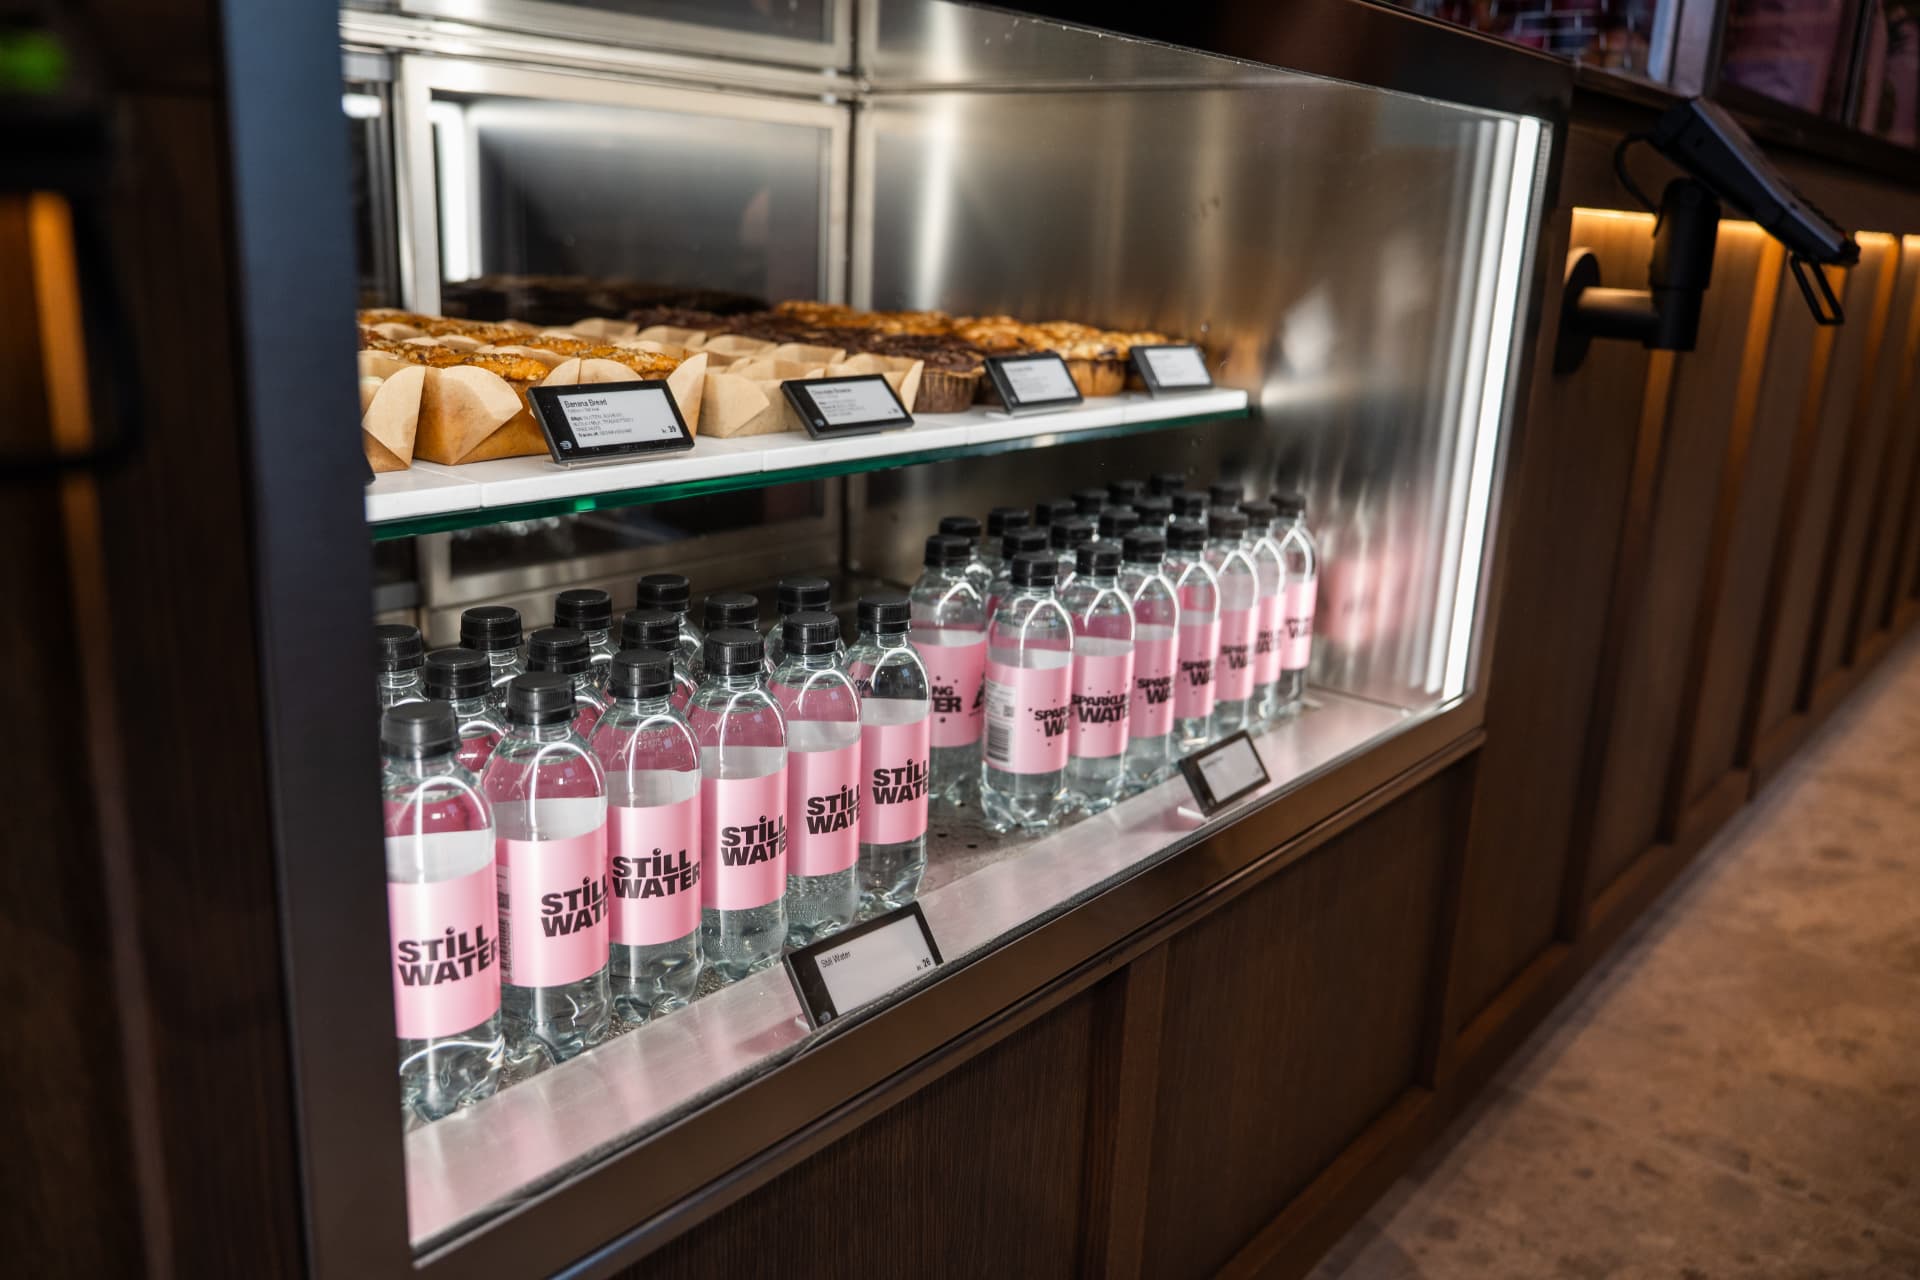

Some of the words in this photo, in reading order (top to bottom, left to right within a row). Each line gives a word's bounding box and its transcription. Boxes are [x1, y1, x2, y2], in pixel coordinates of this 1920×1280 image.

[564, 400, 589, 408] Banana
[588, 398, 607, 407] Bread
[872, 777, 929, 805] WATE
[720, 832, 787, 866] WATE
[612, 860, 701, 899] WATER
[832, 951, 851, 964] Water
